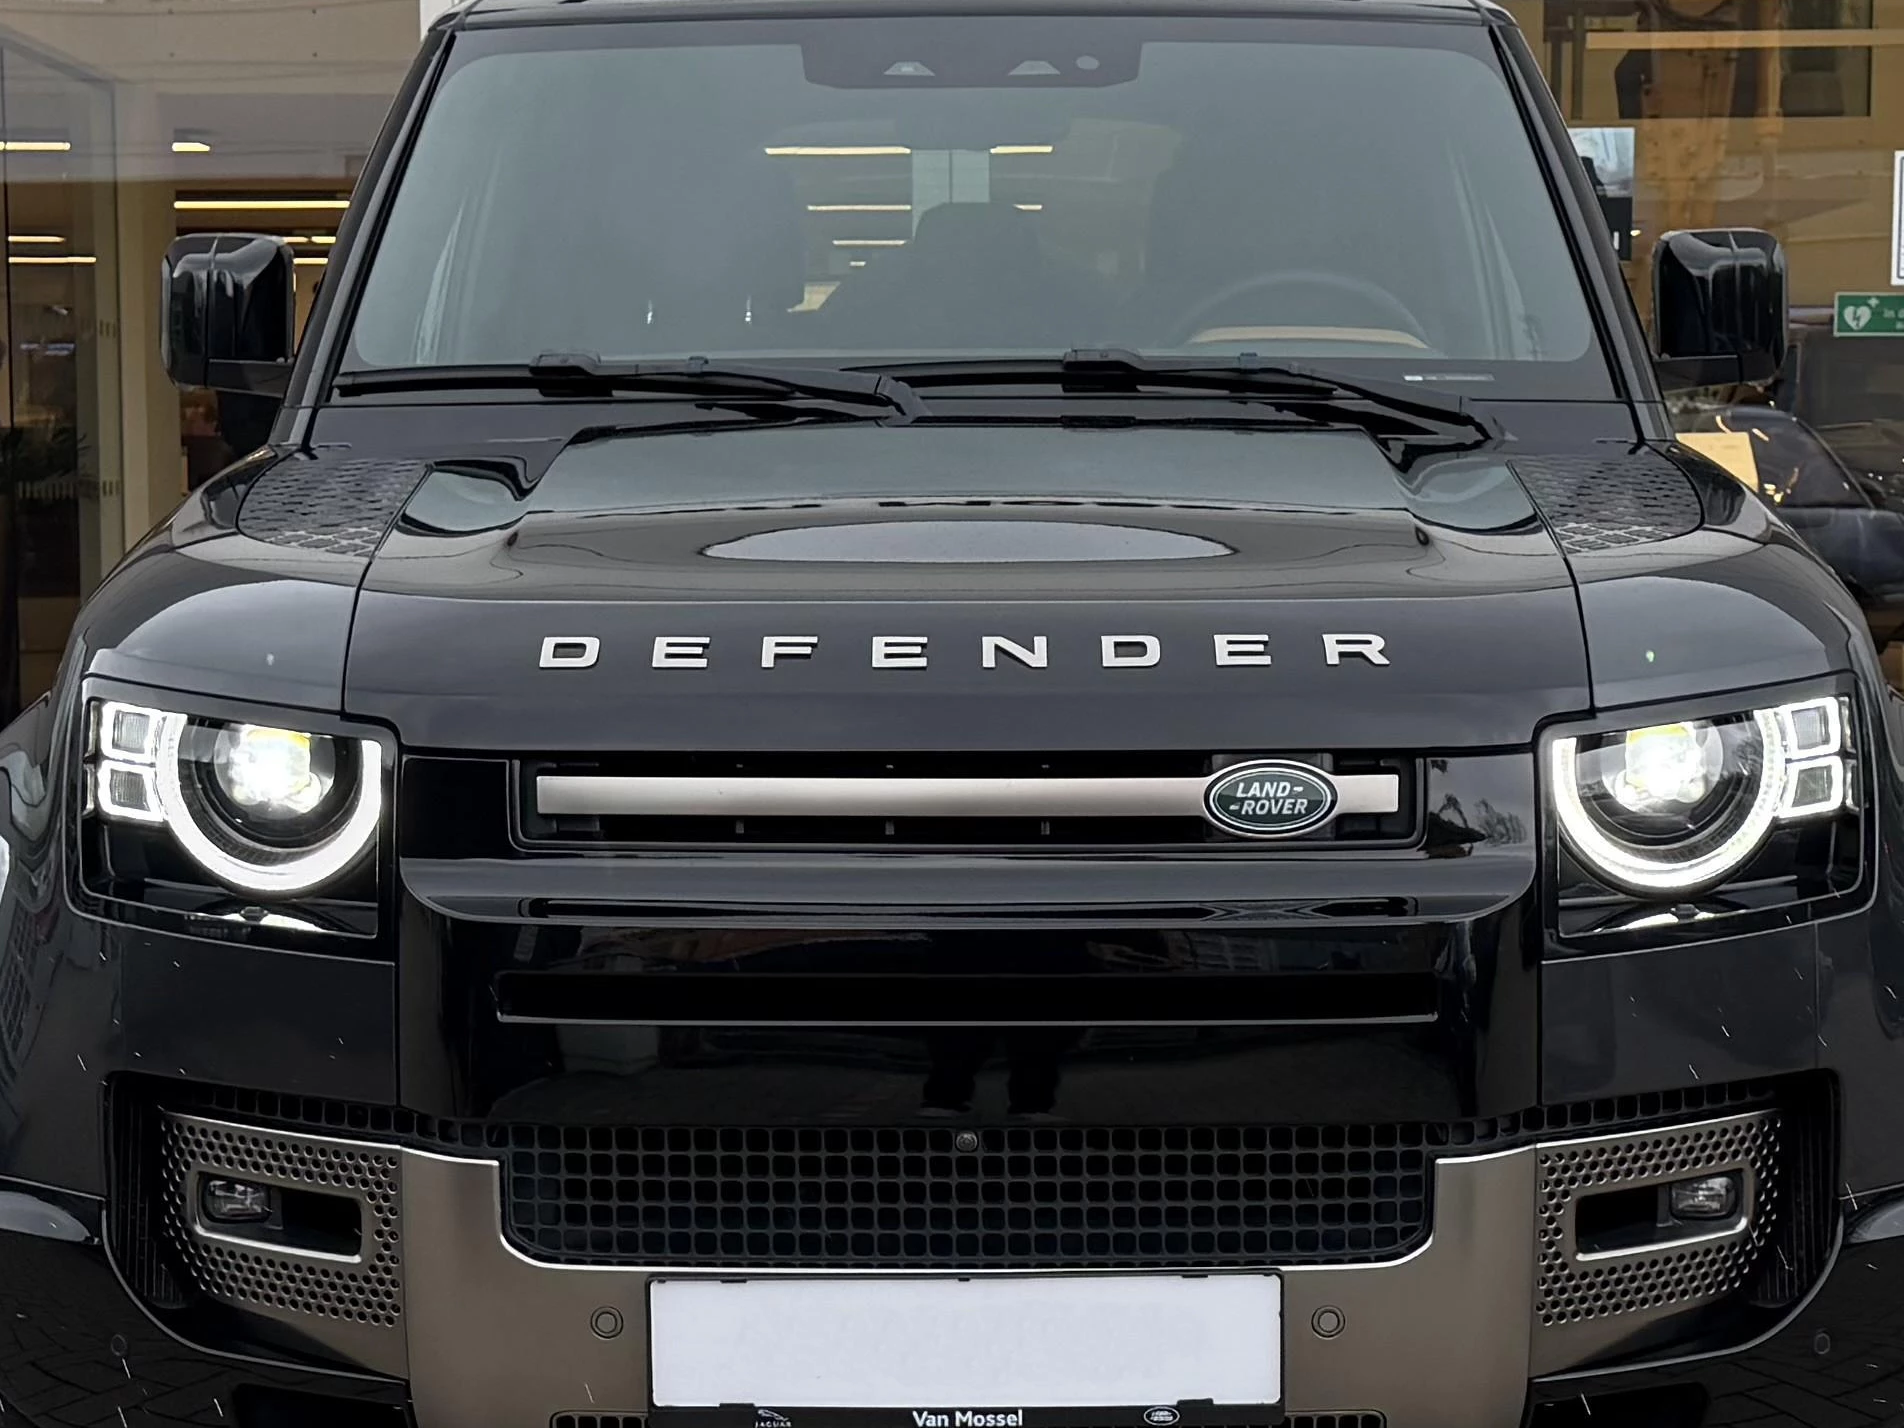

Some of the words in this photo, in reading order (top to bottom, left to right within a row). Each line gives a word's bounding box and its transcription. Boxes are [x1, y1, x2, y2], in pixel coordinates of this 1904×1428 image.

[539, 633, 1391, 670] DEFENDER
[1236, 781, 1291, 798] LAND
[1241, 799, 1309, 815] ROVER
[912, 1410, 950, 1427] Van
[955, 1408, 1023, 1427] Mossel
